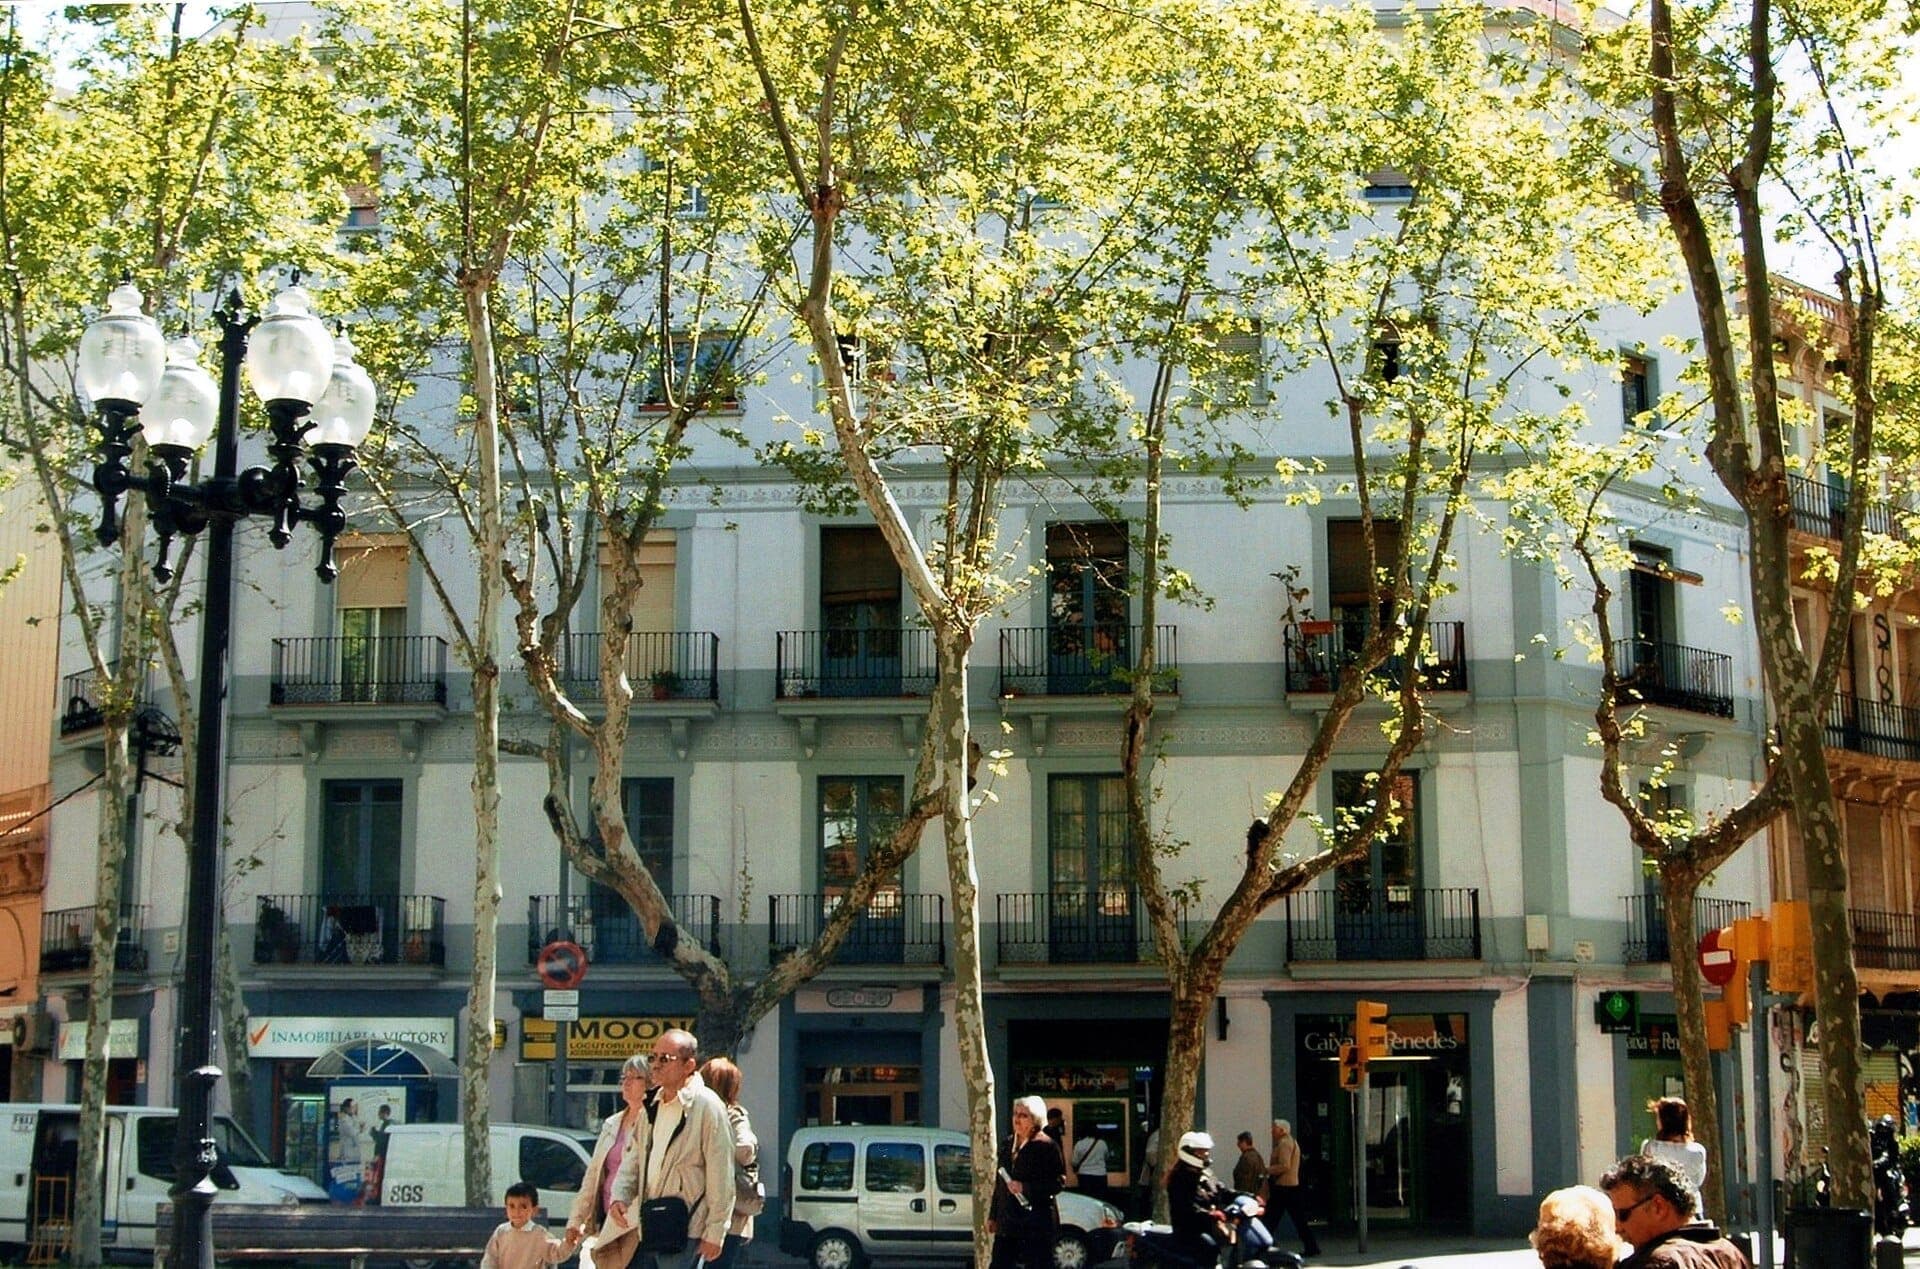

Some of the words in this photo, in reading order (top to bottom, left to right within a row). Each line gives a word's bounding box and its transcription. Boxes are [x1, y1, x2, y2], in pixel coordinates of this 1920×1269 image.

[383, 1031, 449, 1044] VICTORY
[1304, 1032, 1354, 1051] Caixa
[1384, 1030, 1458, 1050] Penedès
[1625, 1032, 1648, 1050] aixa
[1661, 1031, 1680, 1050] Pen
[390, 1185, 423, 1203] SGS
